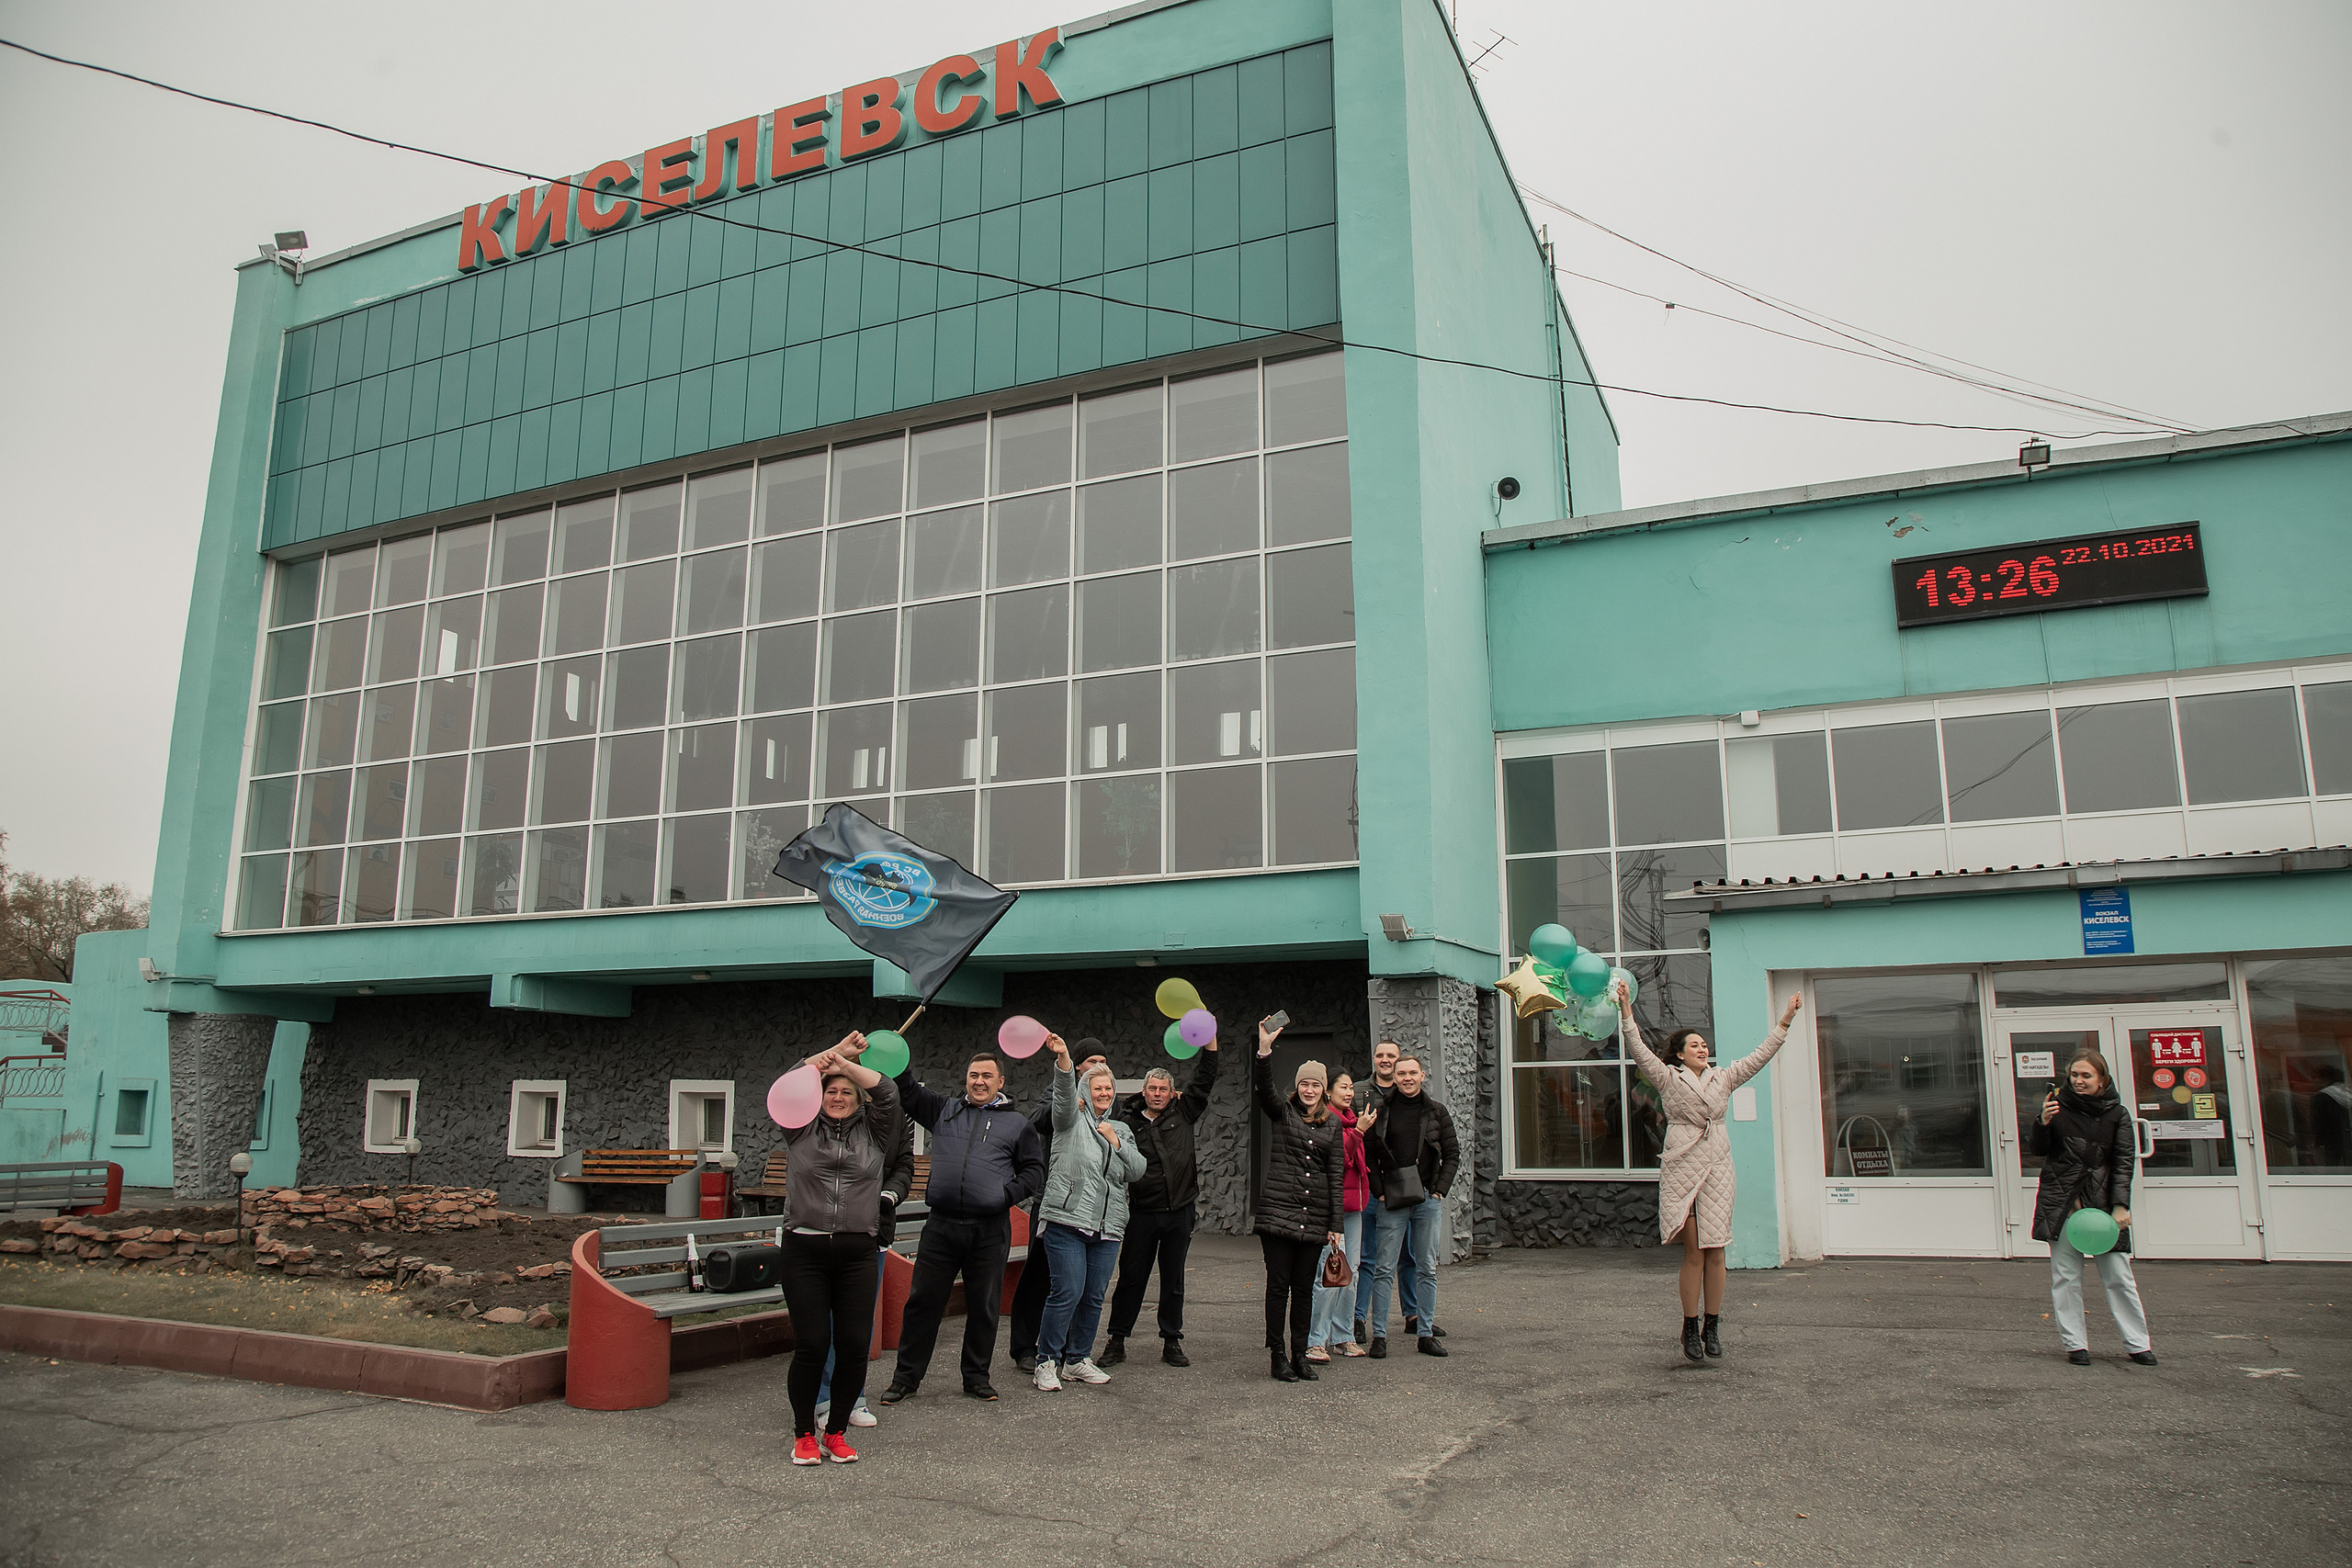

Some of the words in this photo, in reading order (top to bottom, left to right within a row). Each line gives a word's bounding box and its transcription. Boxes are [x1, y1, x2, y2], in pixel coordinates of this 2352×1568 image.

[458, 26, 1066, 275] КИСЕЛЕВСК
[1916, 555, 2060, 607] 13:26
[2060, 534, 2194, 565] 22.10.2021
[2084, 916, 2130, 924] КИСЕЛЕВСК
[1857, 1160, 1888, 1168] ОТДЫХА
